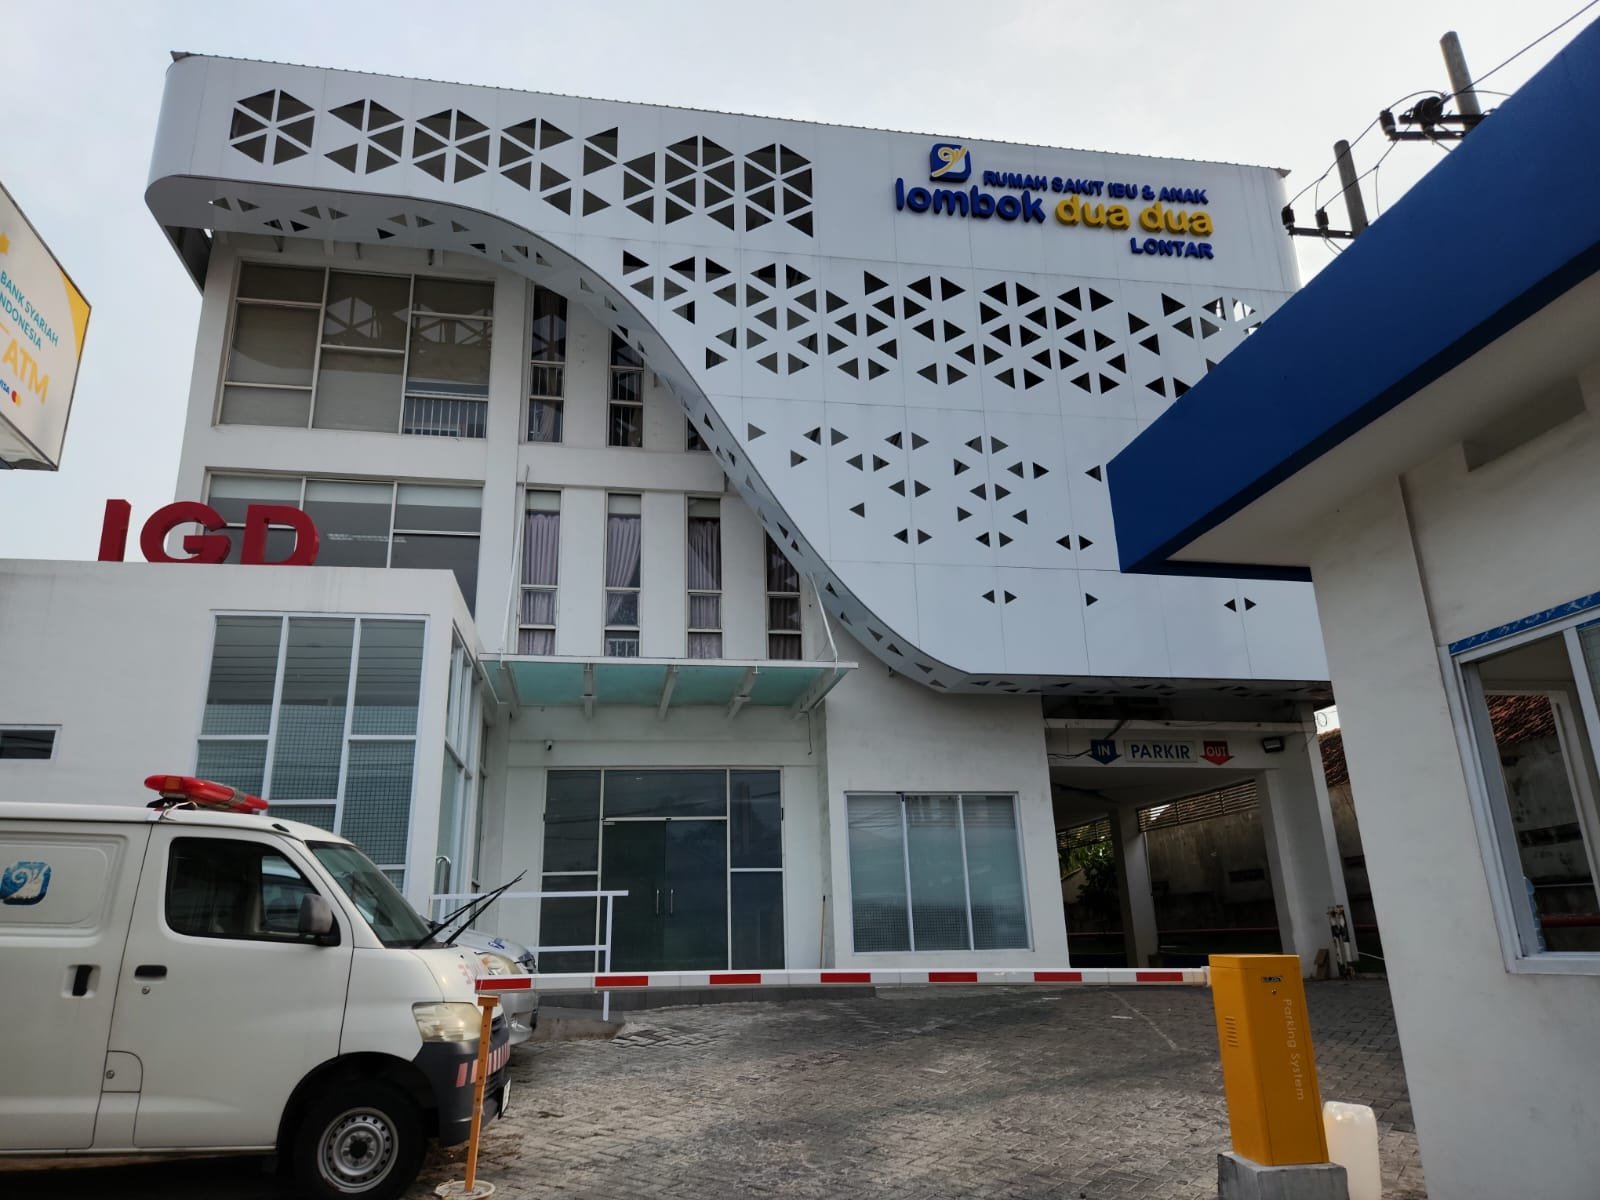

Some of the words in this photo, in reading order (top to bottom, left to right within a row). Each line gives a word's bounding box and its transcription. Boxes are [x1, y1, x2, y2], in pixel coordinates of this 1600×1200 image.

[895, 177, 1046, 223] lombok
[1055, 194, 1131, 230] dua
[1139, 200, 1214, 237] dua
[983, 170, 1048, 192] RUMAH
[1051, 177, 1105, 197] SAKIT
[1108, 183, 1138, 200] IBU
[1141, 184, 1156, 201] &
[1158, 186, 1209, 205] ANAK
[1130, 237, 1214, 260] LONTAR
[0, 271, 25, 306] BANK
[24, 301, 59, 347] SYARIAH
[0, 292, 42, 351] NDONESIA
[2, 338, 49, 405] ATM
[98, 499, 321, 566] IGD
[1098, 744, 1111, 757] IN
[1130, 744, 1191, 760] PARKIR
[1206, 745, 1227, 758] OUT
[1283, 999, 1297, 1048] Parking
